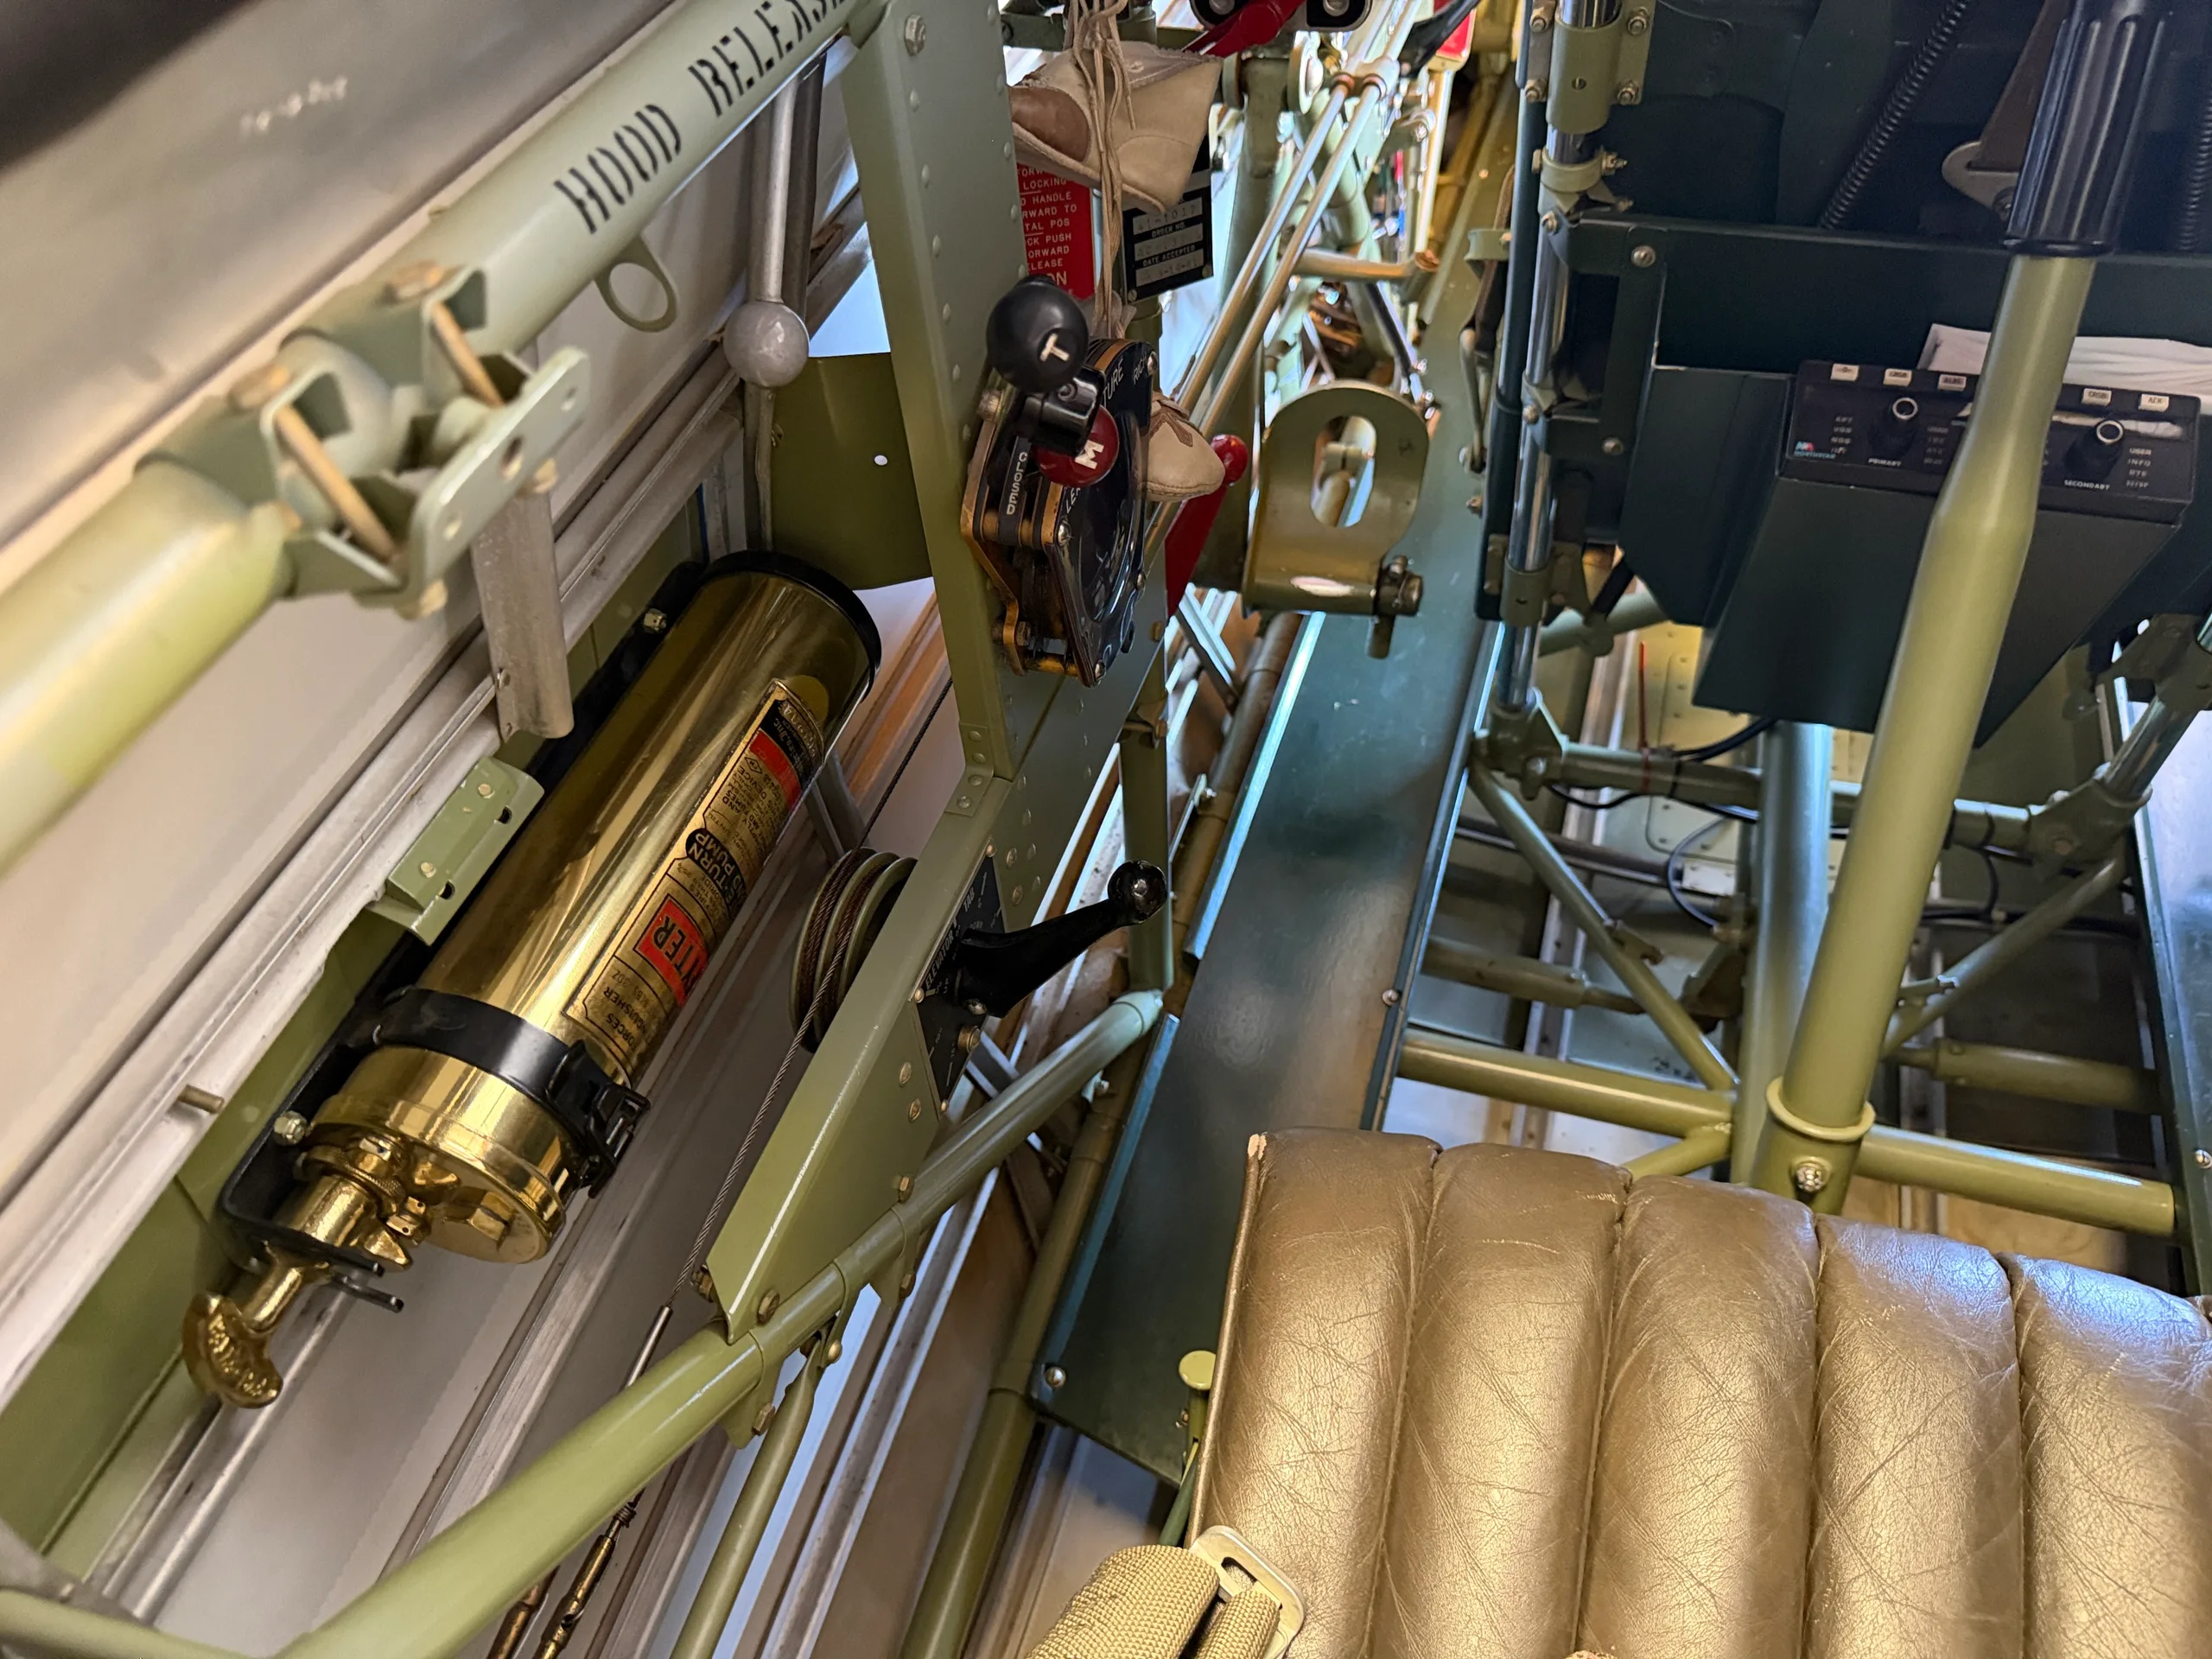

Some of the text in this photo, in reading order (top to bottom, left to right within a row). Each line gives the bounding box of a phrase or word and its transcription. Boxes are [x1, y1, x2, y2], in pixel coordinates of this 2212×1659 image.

[554, 0, 845, 234] HOOD RELEA
[1023, 203, 1077, 219] RWARD TO
[1033, 191, 1072, 206] HANDLE
[1050, 218, 1071, 229] POS
[1027, 245, 1070, 259] ORWARD
[1046, 232, 1072, 244] PUSH
[1027, 257, 1064, 272] ELEASE
[1142, 256, 1160, 268] DATE
[1161, 244, 1197, 261] ACCEPTED
[1040, 333, 1070, 362] T
[1103, 359, 1123, 409] TURE
[1074, 440, 1105, 470] M
[1006, 451, 1028, 516] CLOSED
[736, 765, 767, 799] DEVICE
[720, 795, 741, 815] AND
[724, 788, 750, 816] FUMES
[692, 834, 736, 876] PUMP
[925, 886, 976, 990] ELEVATOR TAB
[652, 918, 703, 994] YTER
